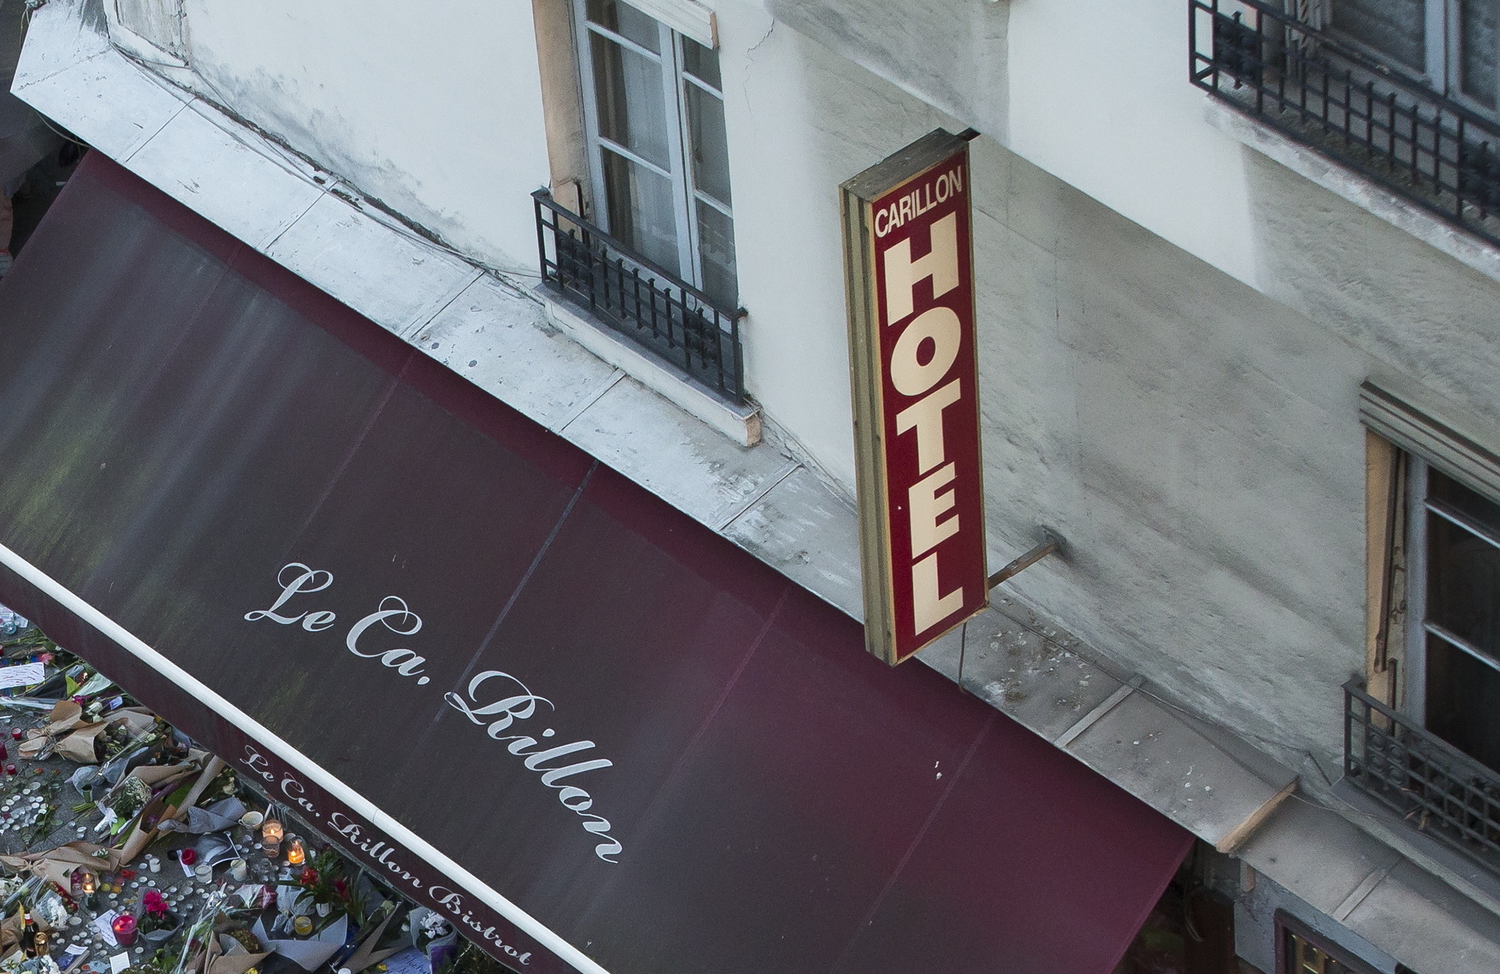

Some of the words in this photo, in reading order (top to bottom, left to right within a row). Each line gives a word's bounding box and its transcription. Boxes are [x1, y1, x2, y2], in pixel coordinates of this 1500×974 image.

[875, 166, 961, 237] CARILLON
[884, 211, 963, 636] HOTEL
[244, 562, 336, 632] Le
[347, 595, 430, 685] Ca.
[444, 670, 623, 864] Rillon
[240, 745, 274, 782] Le
[281, 771, 321, 818] Ca.
[328, 811, 423, 889] Rillon
[429, 885, 532, 966] Bistrot
